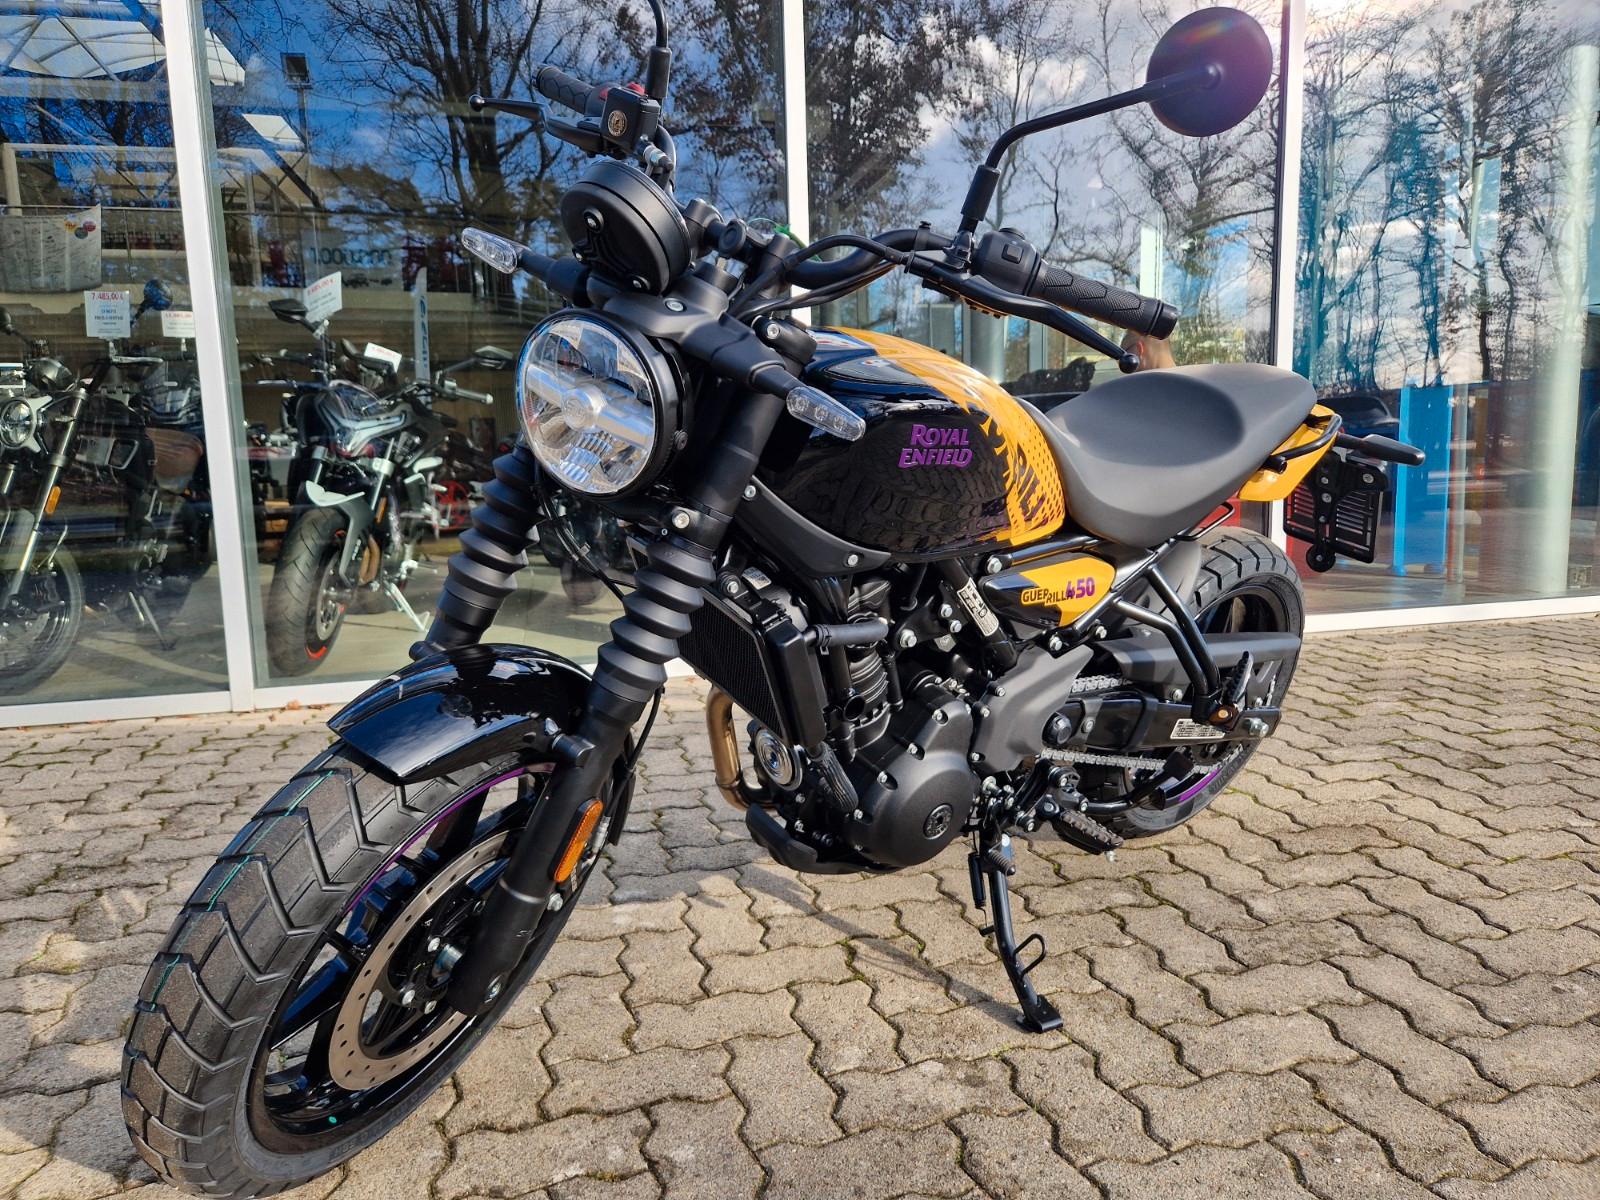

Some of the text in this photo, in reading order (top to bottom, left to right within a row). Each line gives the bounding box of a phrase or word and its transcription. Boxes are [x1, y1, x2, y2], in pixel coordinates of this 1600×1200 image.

[910, 424, 969, 448] ROYAL
[898, 448, 973, 468] ENFIELD
[1066, 577, 1096, 599] 450
